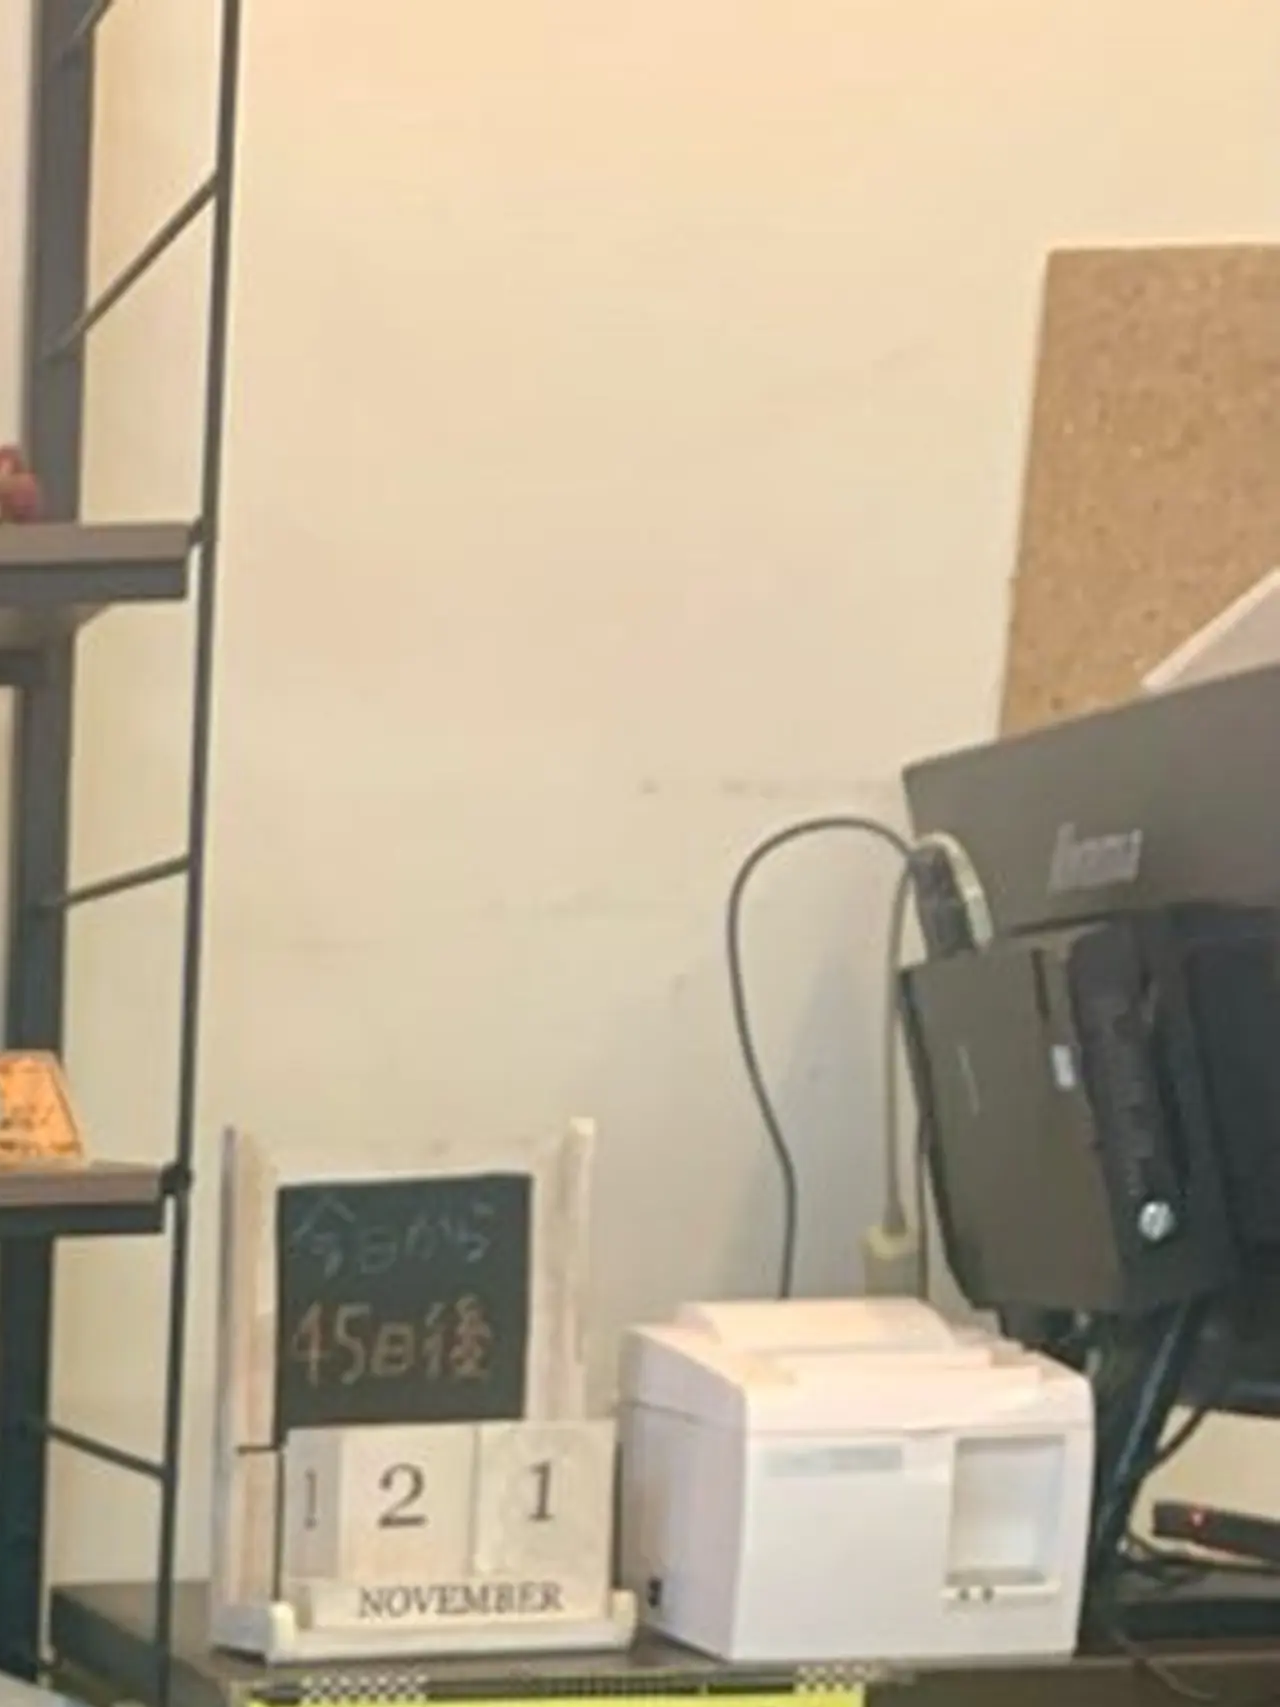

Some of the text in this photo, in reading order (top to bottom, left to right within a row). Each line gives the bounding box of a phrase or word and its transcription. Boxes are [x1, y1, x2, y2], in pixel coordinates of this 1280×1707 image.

[290, 1292, 491, 1388] 45日後
[376, 1463, 429, 1529] 2
[527, 1461, 555, 1522] 1
[358, 1581, 565, 1620] NOVEMBER
